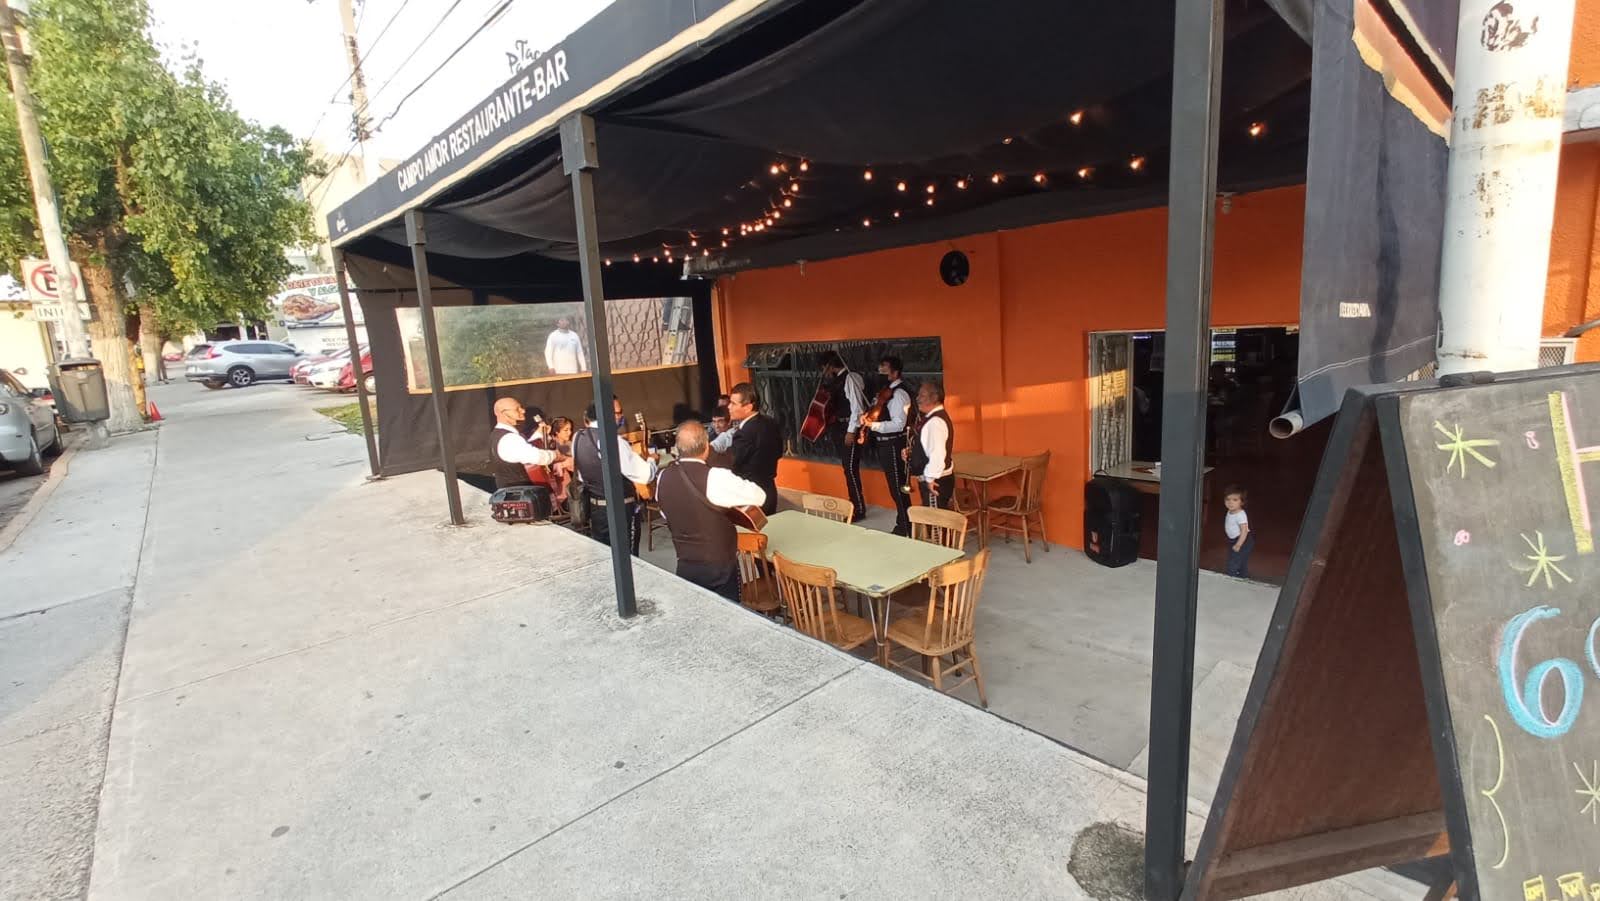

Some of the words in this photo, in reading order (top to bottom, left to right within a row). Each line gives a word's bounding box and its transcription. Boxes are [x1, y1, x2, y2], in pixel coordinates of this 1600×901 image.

[515, 39, 541, 62] Tac
[505, 51, 523, 75] Pa
[397, 162, 425, 192] CAMPO
[425, 138, 451, 177] AMOR
[450, 50, 569, 159] RESTAURANTE-BAR
